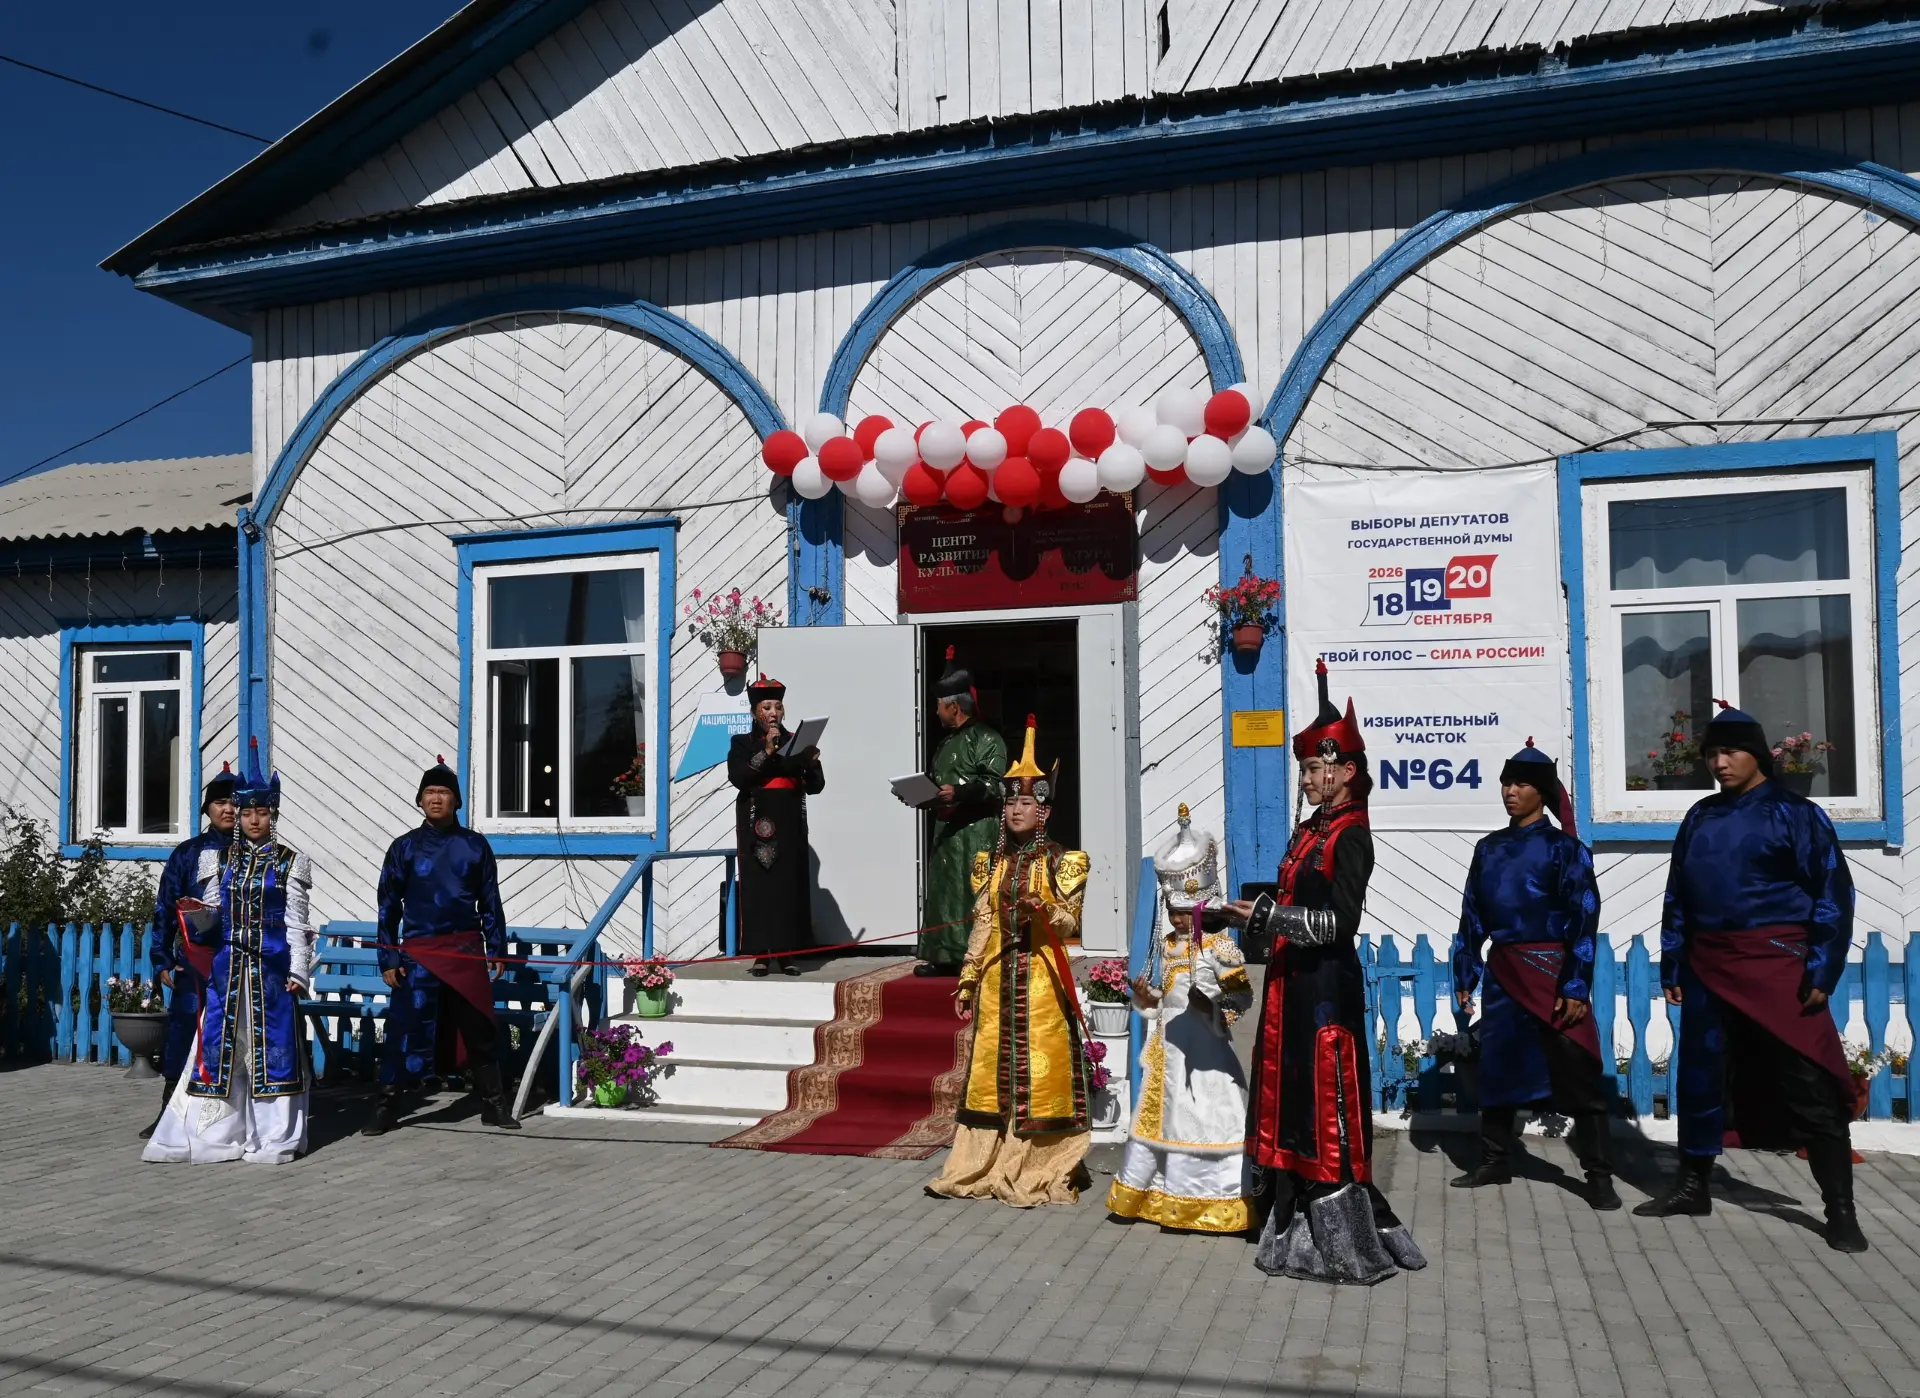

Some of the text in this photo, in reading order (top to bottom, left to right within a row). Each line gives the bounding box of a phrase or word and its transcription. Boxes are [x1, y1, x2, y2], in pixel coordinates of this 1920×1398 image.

[1350, 513, 1510, 531] ВЫБОРЫ ДЕПУТАТОВ
[931, 535, 977, 549] ЦЕНТР
[1347, 532, 1513, 549] ГОСУДАРСТВЕННОЙ ДУМЫ
[918, 549, 990, 563] РАЗВИТИЯ
[1368, 566, 1403, 578] 2026
[1372, 564, 1488, 616] 18 19 20
[1413, 612, 1493, 626] СЕНТЯБРЯ
[1319, 648, 1359, 662] ТВОЙ
[1362, 649, 1413, 662] ГОЛОС
[1430, 648, 1472, 660] СИЛА
[1476, 646, 1545, 659] РОССИИ!
[701, 715, 752, 726] НАЦИОНАЛЬН
[1363, 712, 1499, 728] ИЗБИРАТЕЛЬНЫЙ
[727, 725, 752, 735] ПРОЕК
[1394, 732, 1467, 744] УЧАСТОК
[1379, 758, 1483, 790] №64
